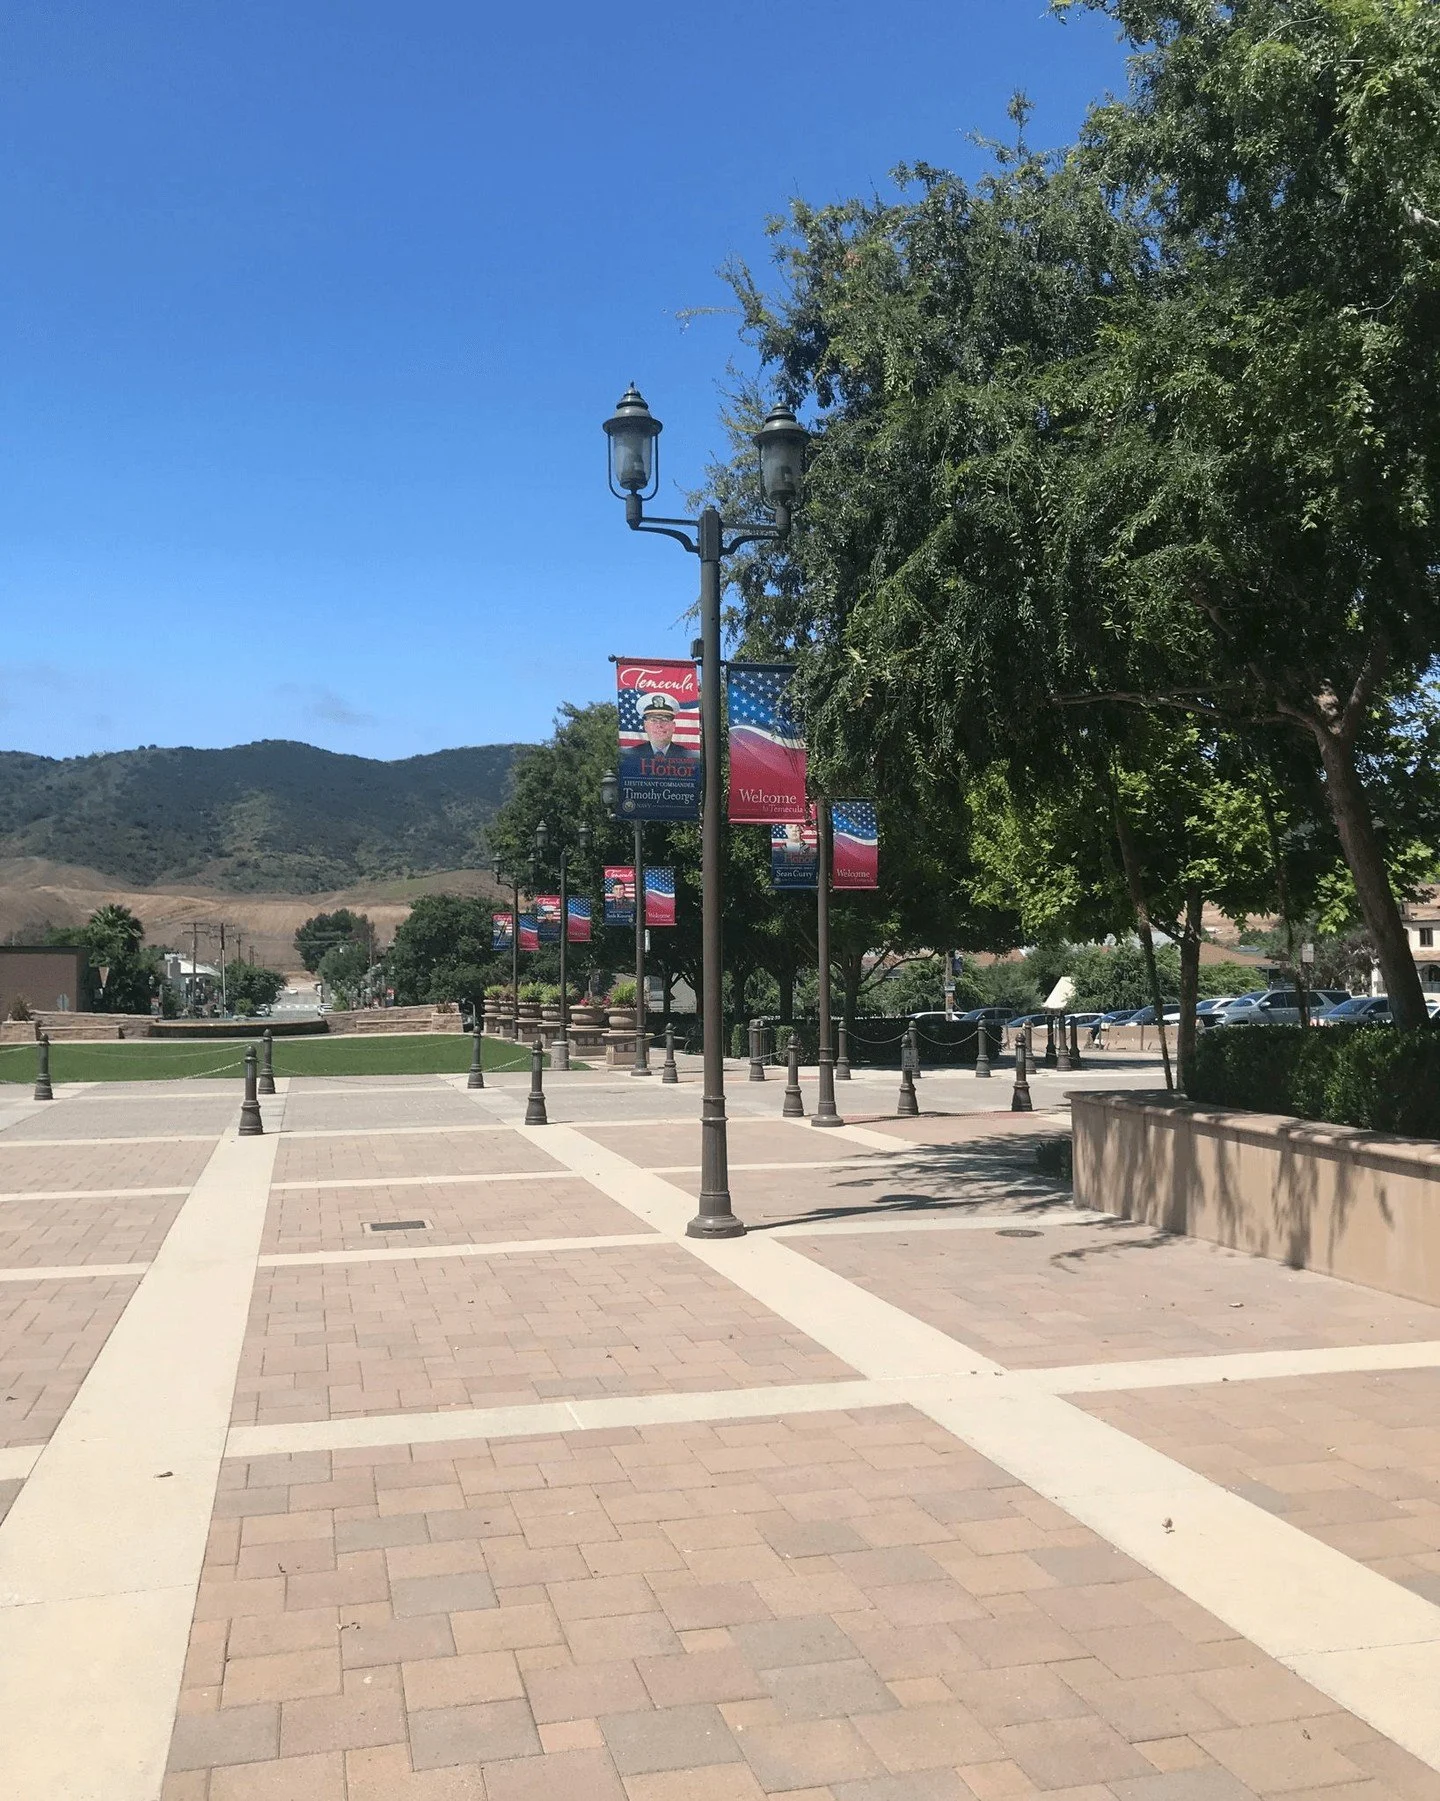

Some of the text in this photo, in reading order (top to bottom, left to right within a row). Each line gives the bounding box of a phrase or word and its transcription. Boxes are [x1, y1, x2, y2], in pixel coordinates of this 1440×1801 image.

[620, 667, 693, 693] Temecula
[641, 758, 695, 777] Honor
[624, 780, 659, 788] LIEUTENANT
[623, 787, 694, 804] Timothy George
[739, 788, 797, 804] Welcome
[769, 804, 803, 813] Temecula
[836, 868, 871, 878] Welcome
